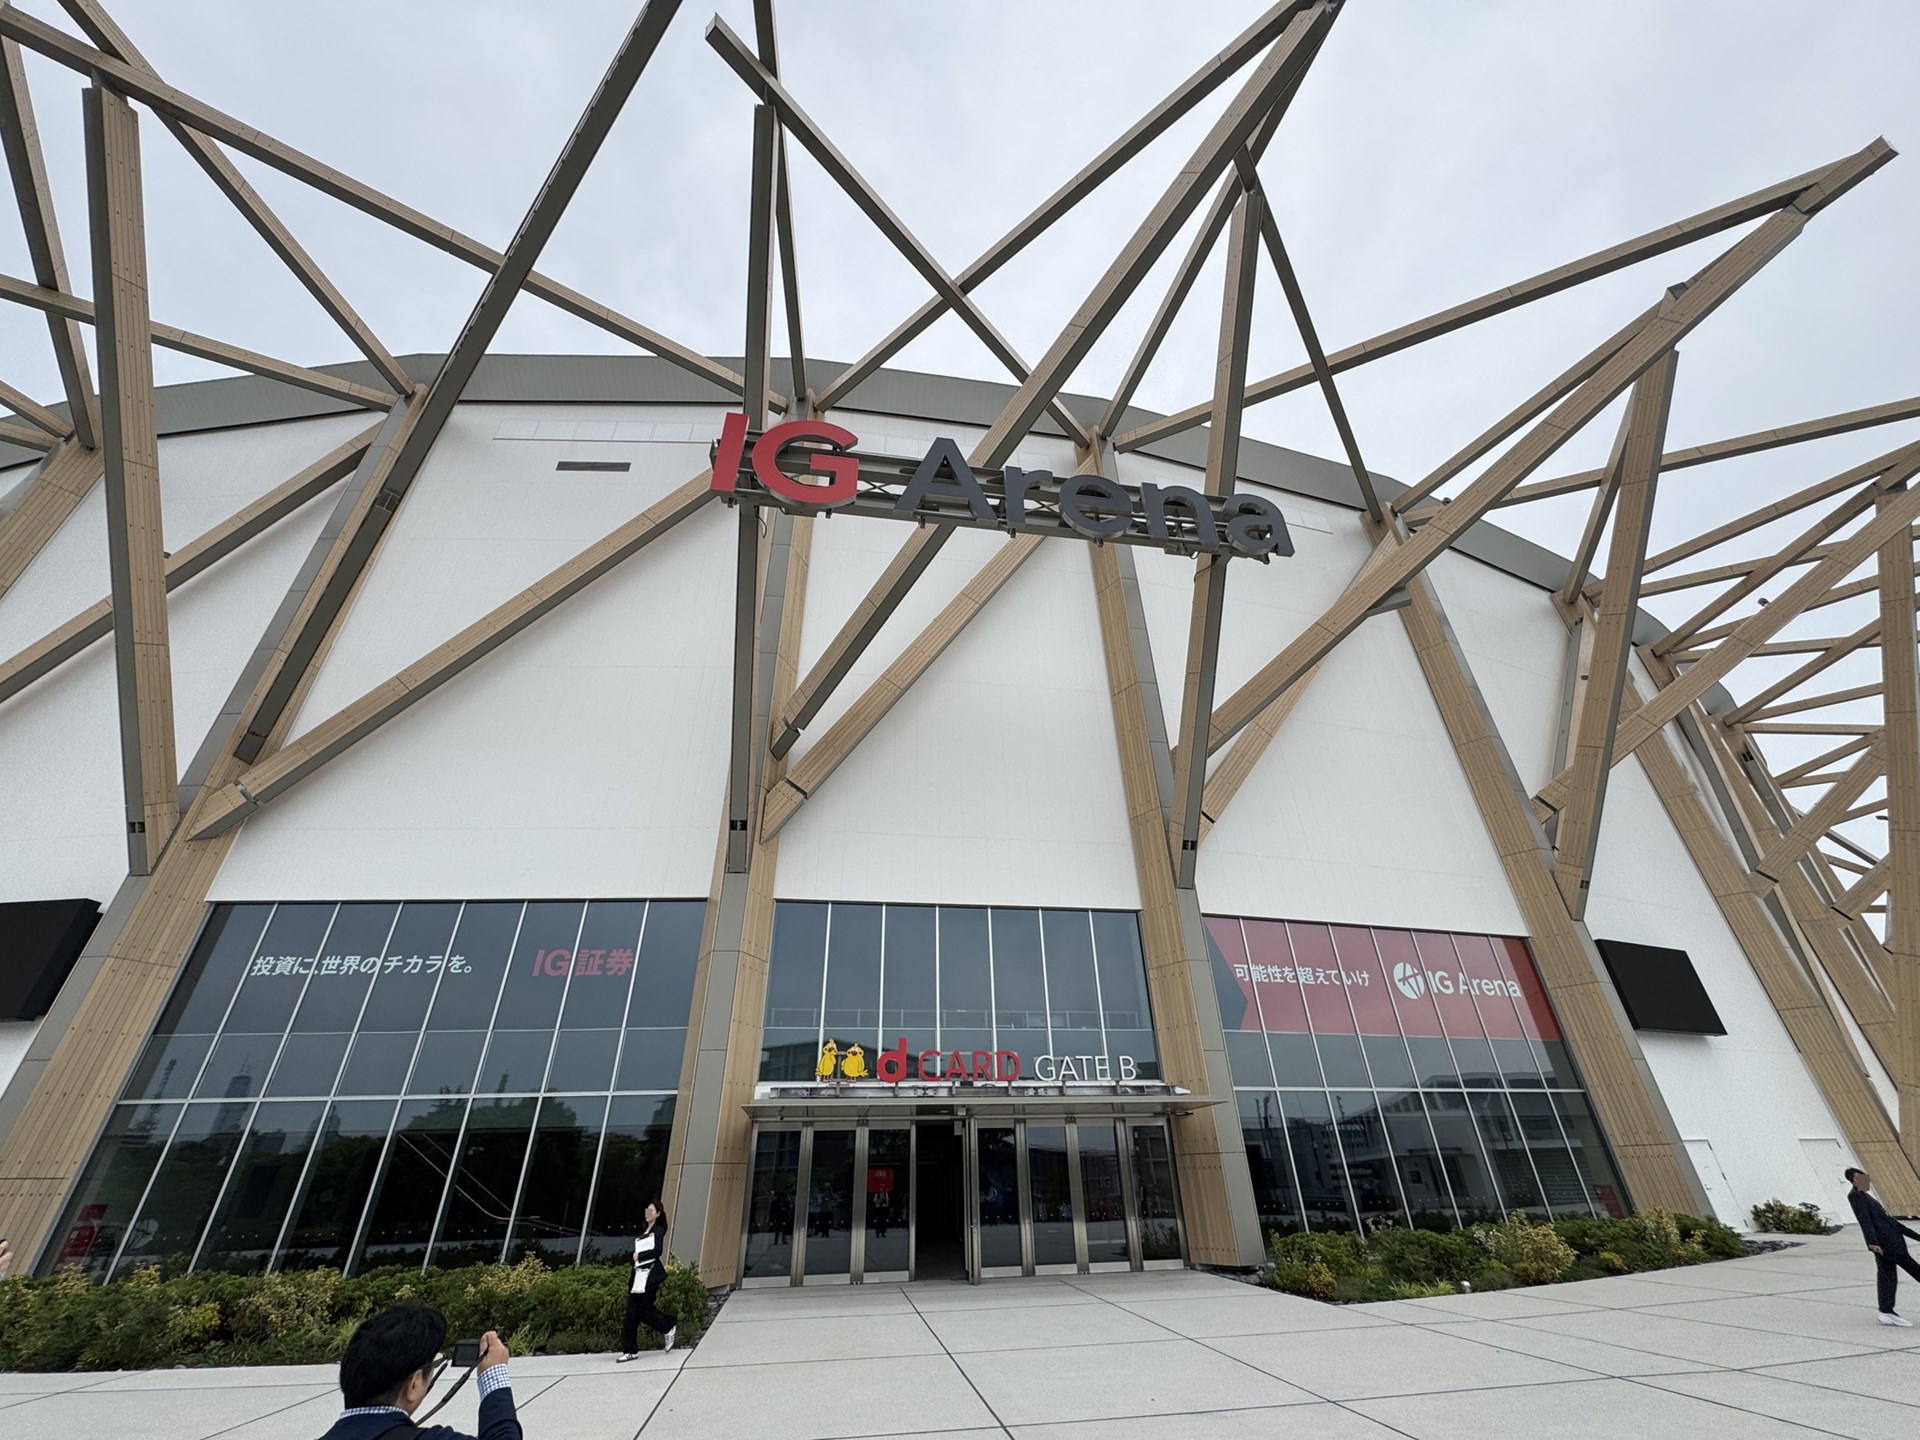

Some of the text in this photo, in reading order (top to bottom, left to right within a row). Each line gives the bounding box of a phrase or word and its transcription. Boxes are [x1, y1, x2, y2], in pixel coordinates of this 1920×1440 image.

[710, 412, 1294, 557] IG Arena
[1233, 963, 1370, 987] 可能性を超えていけ
[1428, 970, 1522, 998] IG Arena
[877, 1037, 1137, 1083] d CARD GATE B
